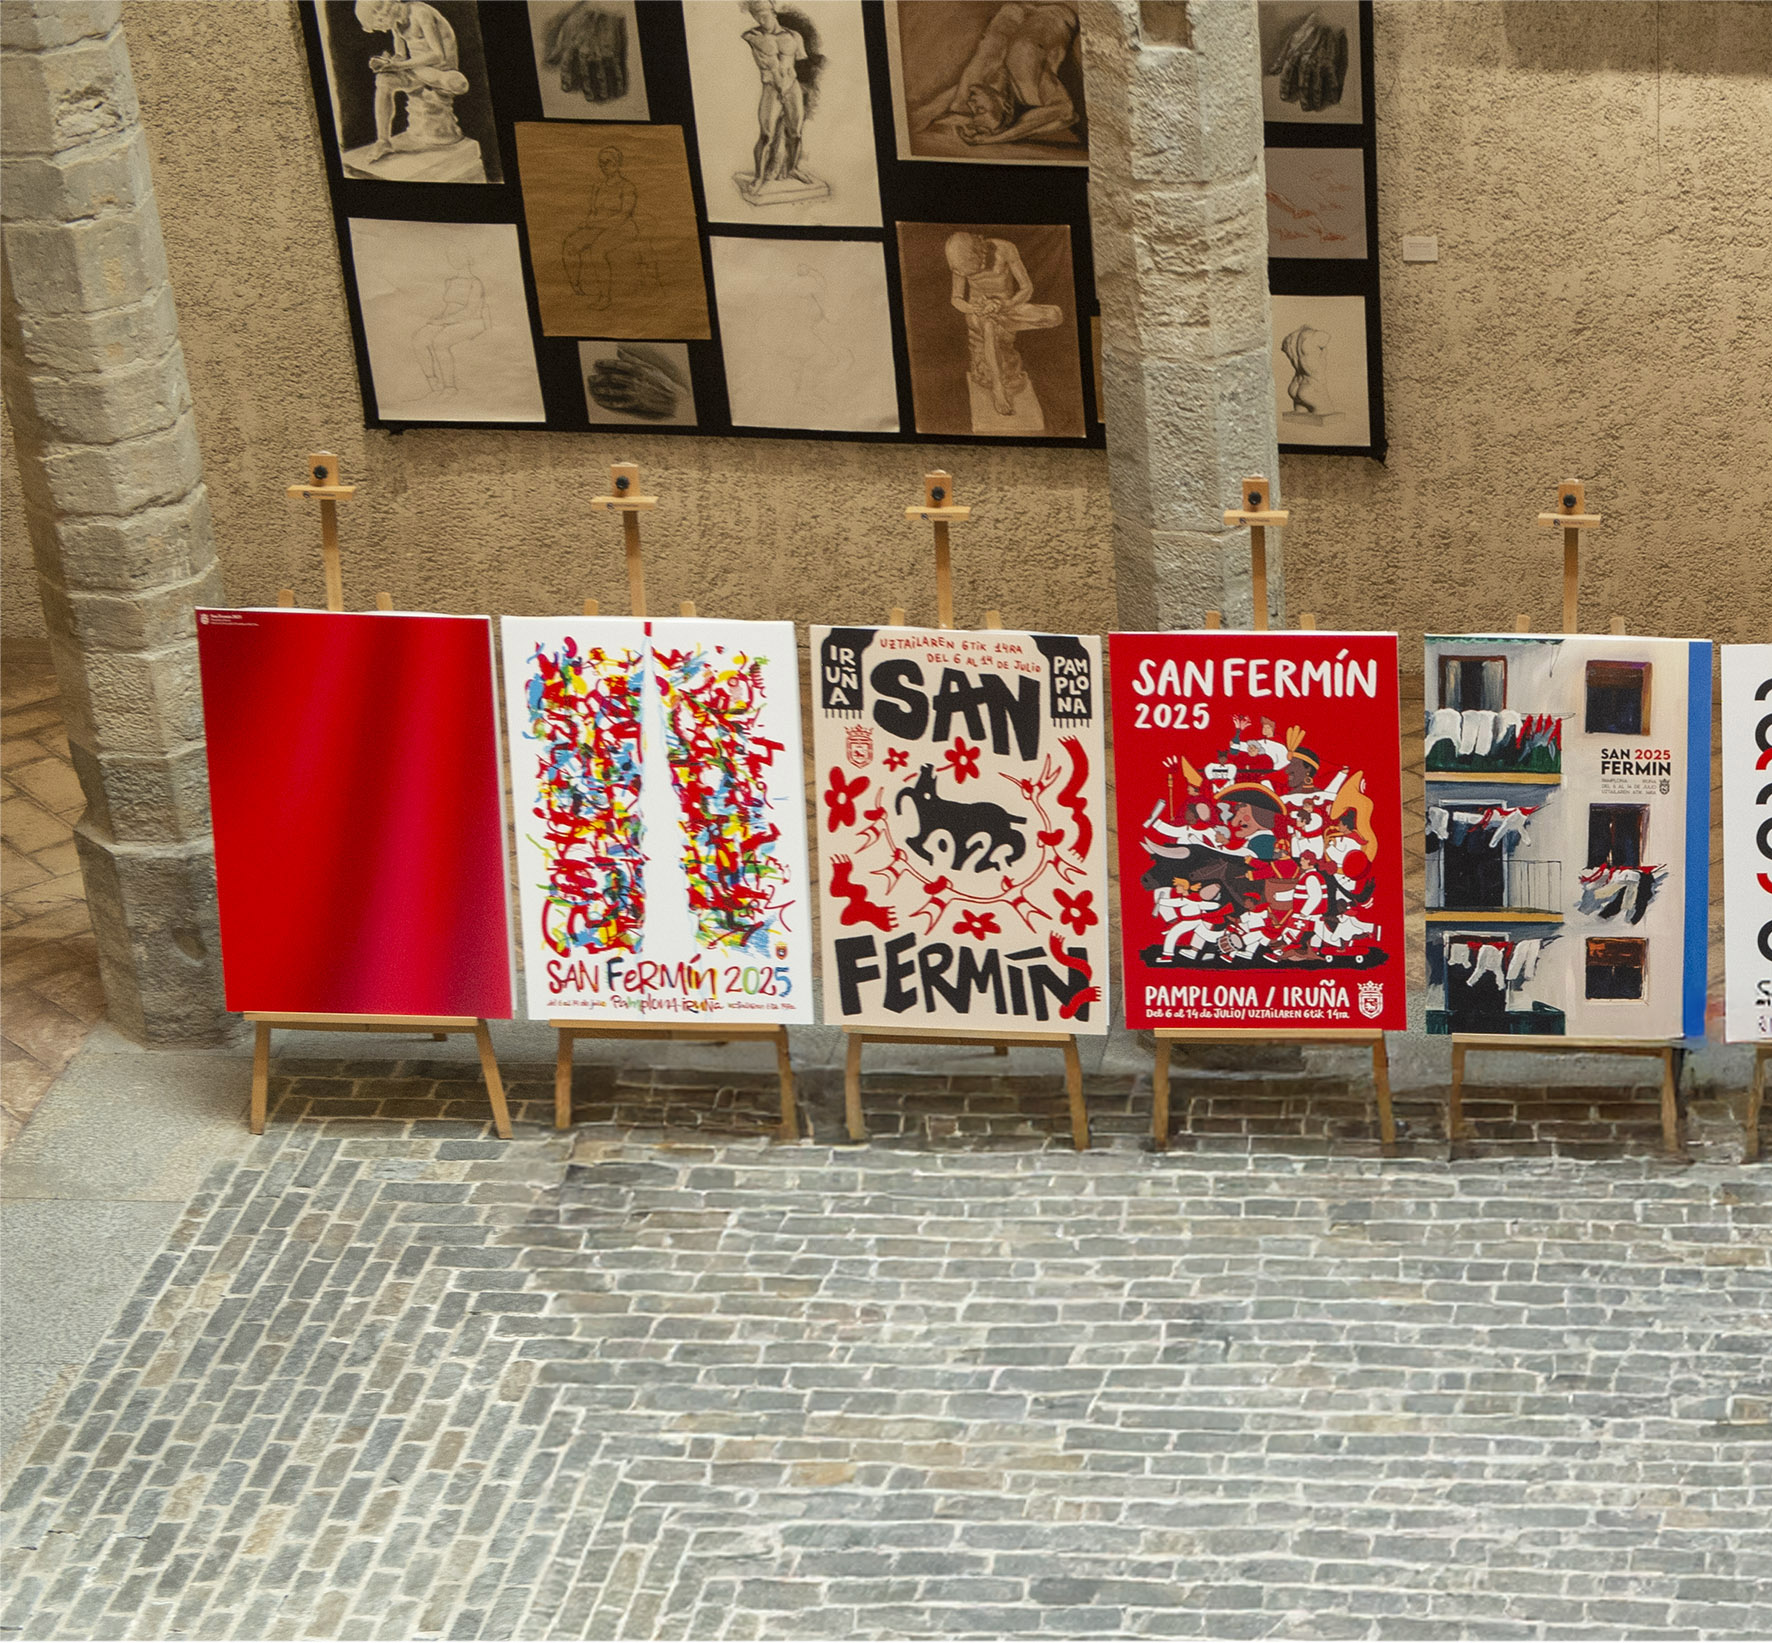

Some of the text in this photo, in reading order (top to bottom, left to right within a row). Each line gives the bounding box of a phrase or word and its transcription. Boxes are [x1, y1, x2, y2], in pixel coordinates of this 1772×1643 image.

[926, 653, 949, 663] DEL
[953, 654, 961, 664] 6
[965, 657, 978, 667] AL
[981, 655, 993, 665] 14
[997, 660, 1009, 670] DE
[1053, 656, 1089, 674] PAM
[1131, 648, 1377, 698] SAN FERMÍN
[1055, 676, 1090, 697] PLO
[870, 658, 1041, 762] SAN
[1057, 697, 1087, 715] NA
[1134, 703, 1210, 730] 2025
[1601, 748, 1671, 760] SAN 2025
[1601, 761, 1671, 776] FERMIN
[547, 959, 599, 994] SAN
[724, 966, 793, 998] 2025
[834, 932, 1090, 1022] FERMÍN
[1145, 979, 1350, 1009] PAMPLONA / IRUÑA
[1165, 1009, 1172, 1018] 6
[1186, 1008, 1198, 1019] 14
